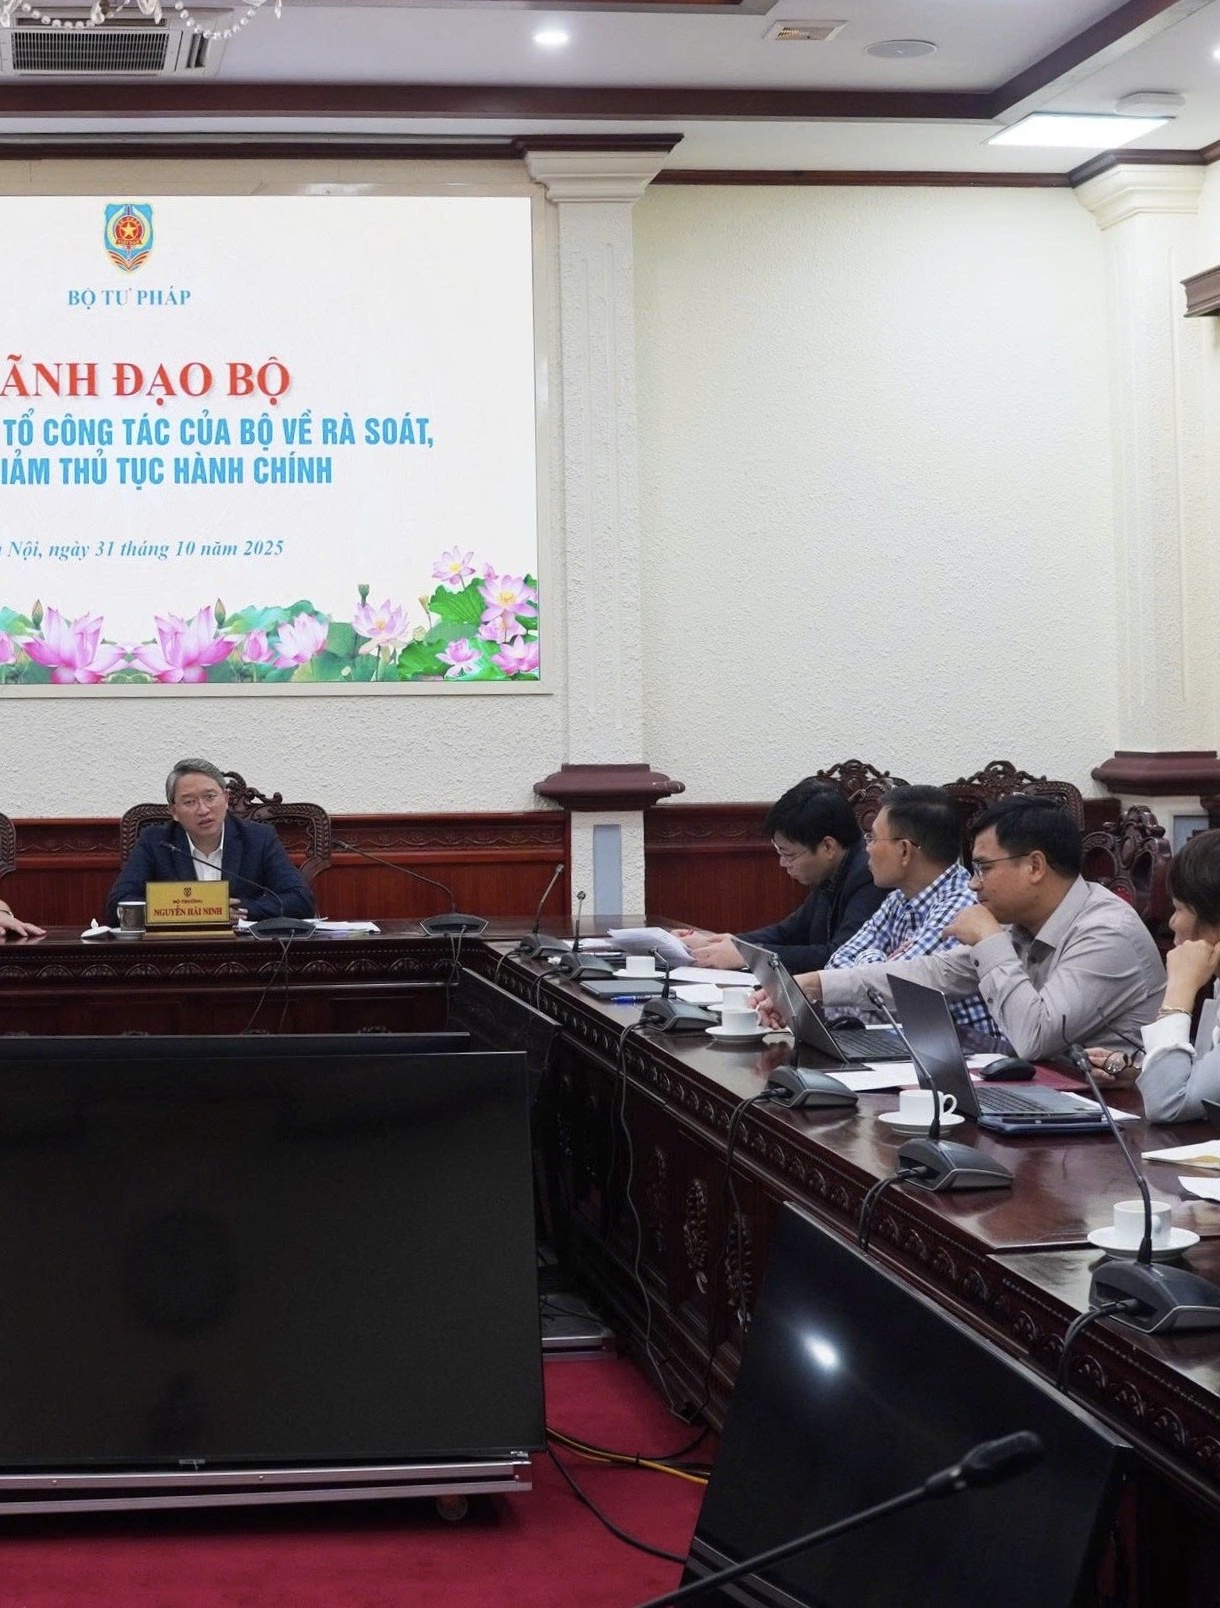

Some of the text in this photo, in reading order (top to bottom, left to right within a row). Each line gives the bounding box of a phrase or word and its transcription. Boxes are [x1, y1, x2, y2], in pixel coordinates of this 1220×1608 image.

[67, 285, 192, 310] BỘ TƯ PHÁP
[112, 361, 214, 407] ĐẠO
[226, 356, 291, 407] BỘ
[3, 407, 36, 446] TỔ
[43, 412, 114, 447] CÔNG
[122, 412, 171, 446] TÁC
[180, 408, 232, 446] CỦA
[240, 412, 275, 452] BỘ
[282, 409, 313, 446] VỀ
[322, 412, 357, 446] RÀ
[365, 412, 434, 449] SOÁT,
[59, 448, 108, 486] THỦ
[116, 457, 166, 491] TỤC
[174, 451, 245, 485] HÀNH
[253, 450, 333, 485] CHÍNH
[7, 540, 43, 561] Nội,
[48, 540, 90, 561] ngày
[95, 540, 115, 557] 31
[120, 540, 170, 561] tháng
[176, 540, 196, 557] 10
[200, 541, 238, 557] năm
[243, 539, 284, 557] 2025
[154, 905, 186, 917] NGUYỄN
[203, 907, 223, 916] NINH
